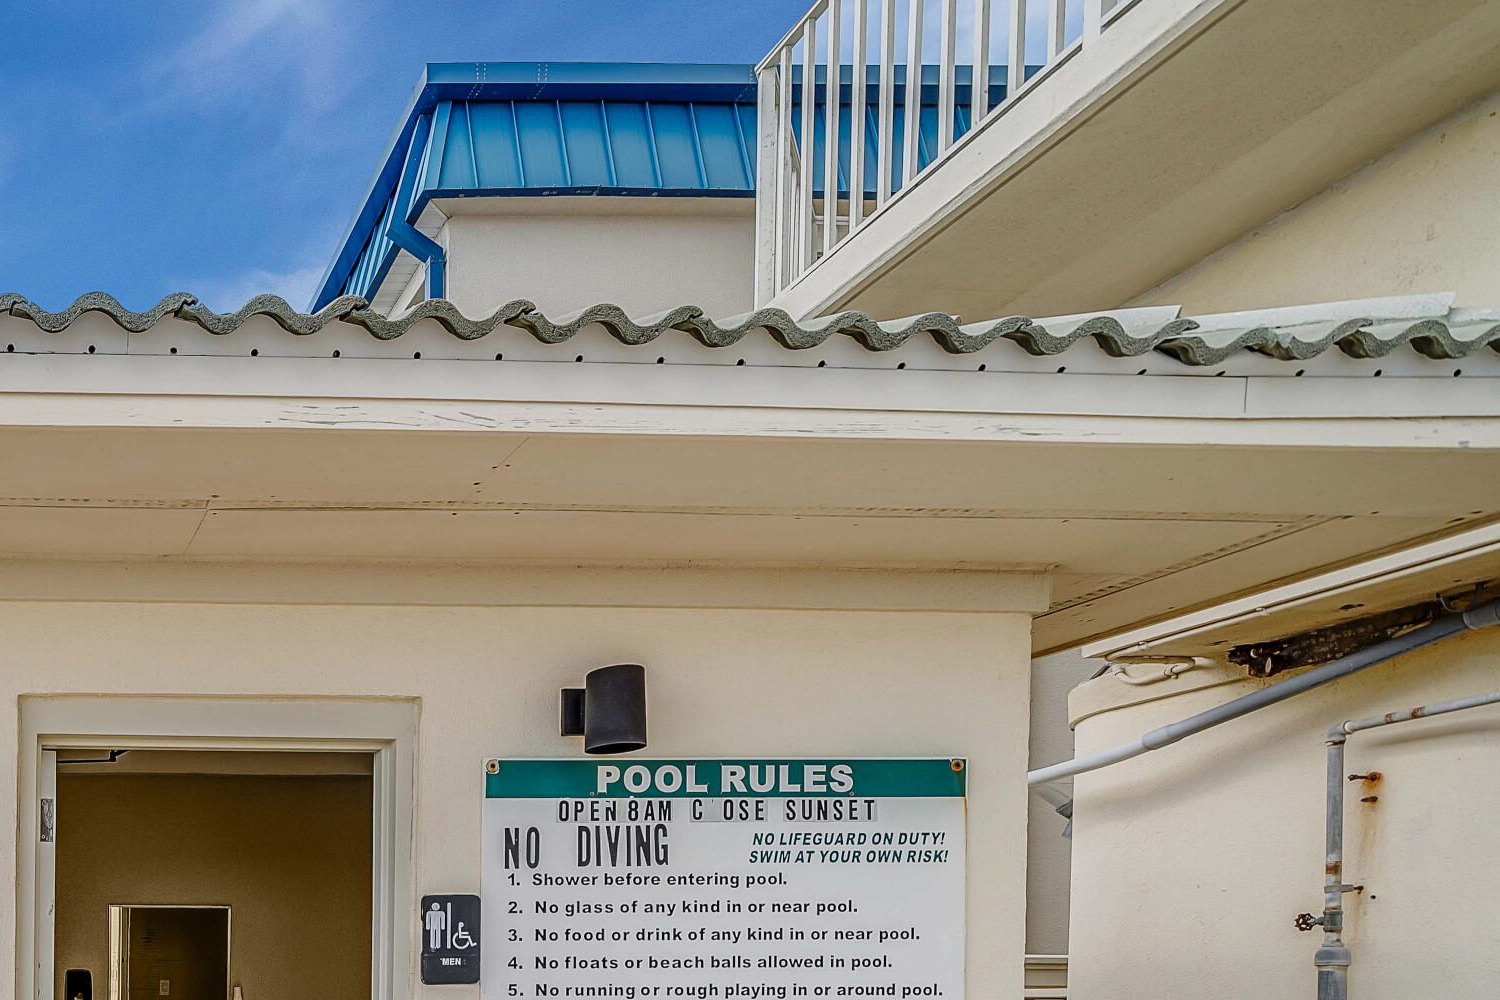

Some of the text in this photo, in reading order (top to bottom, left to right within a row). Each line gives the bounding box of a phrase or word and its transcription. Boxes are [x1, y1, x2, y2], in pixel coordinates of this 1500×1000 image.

[596, 764, 855, 793] POOL RULES
[559, 799, 874, 821] OPEN 8AM COSE SUNSET
[505, 824, 668, 869] NO DIVING
[753, 833, 945, 845] NO LIFEGUARD ON DUTY!
[749, 850, 948, 863] SWIM AT YOUR OWN RISK!
[508, 873, 786, 888] 1. Shower before entering pool.
[508, 900, 857, 916] 2. No glass of any kind in or near pool.
[508, 928, 919, 943] 3. No food or drink of any kind in or near pool.
[442, 957, 462, 966] MEN
[508, 955, 891, 970] 4. No floats or beach balls allowed in pool.
[508, 983, 942, 999] 5. No running or rough playing in or around pool.
